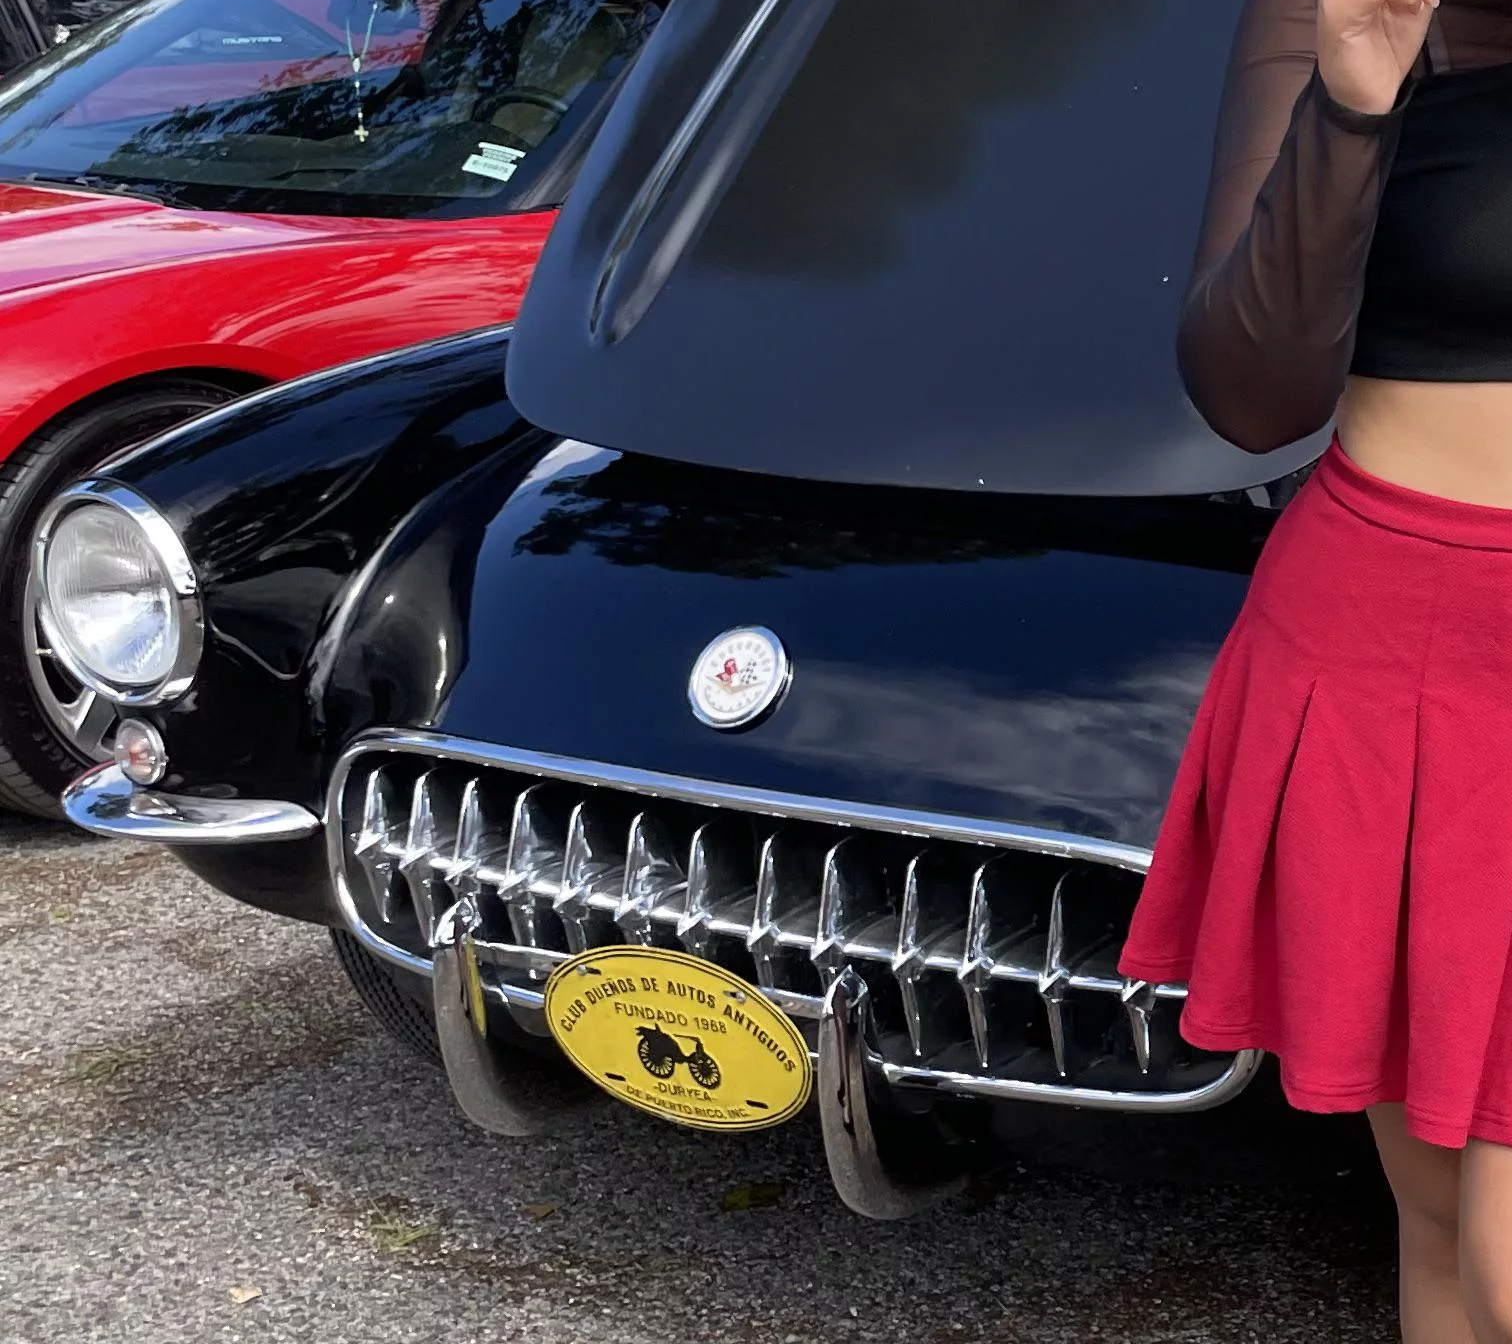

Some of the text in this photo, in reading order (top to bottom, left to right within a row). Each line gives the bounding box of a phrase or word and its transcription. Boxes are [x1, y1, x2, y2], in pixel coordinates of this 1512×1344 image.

[560, 999, 587, 1032] CLUB
[640, 977, 660, 993] DE
[667, 981, 717, 1009] AUTOS
[723, 1004, 797, 1072] ANTIGUOS
[614, 1001, 689, 1027] FUNDADO
[626, 1084, 641, 1098] DE
[645, 1093, 692, 1115] PUERTO
